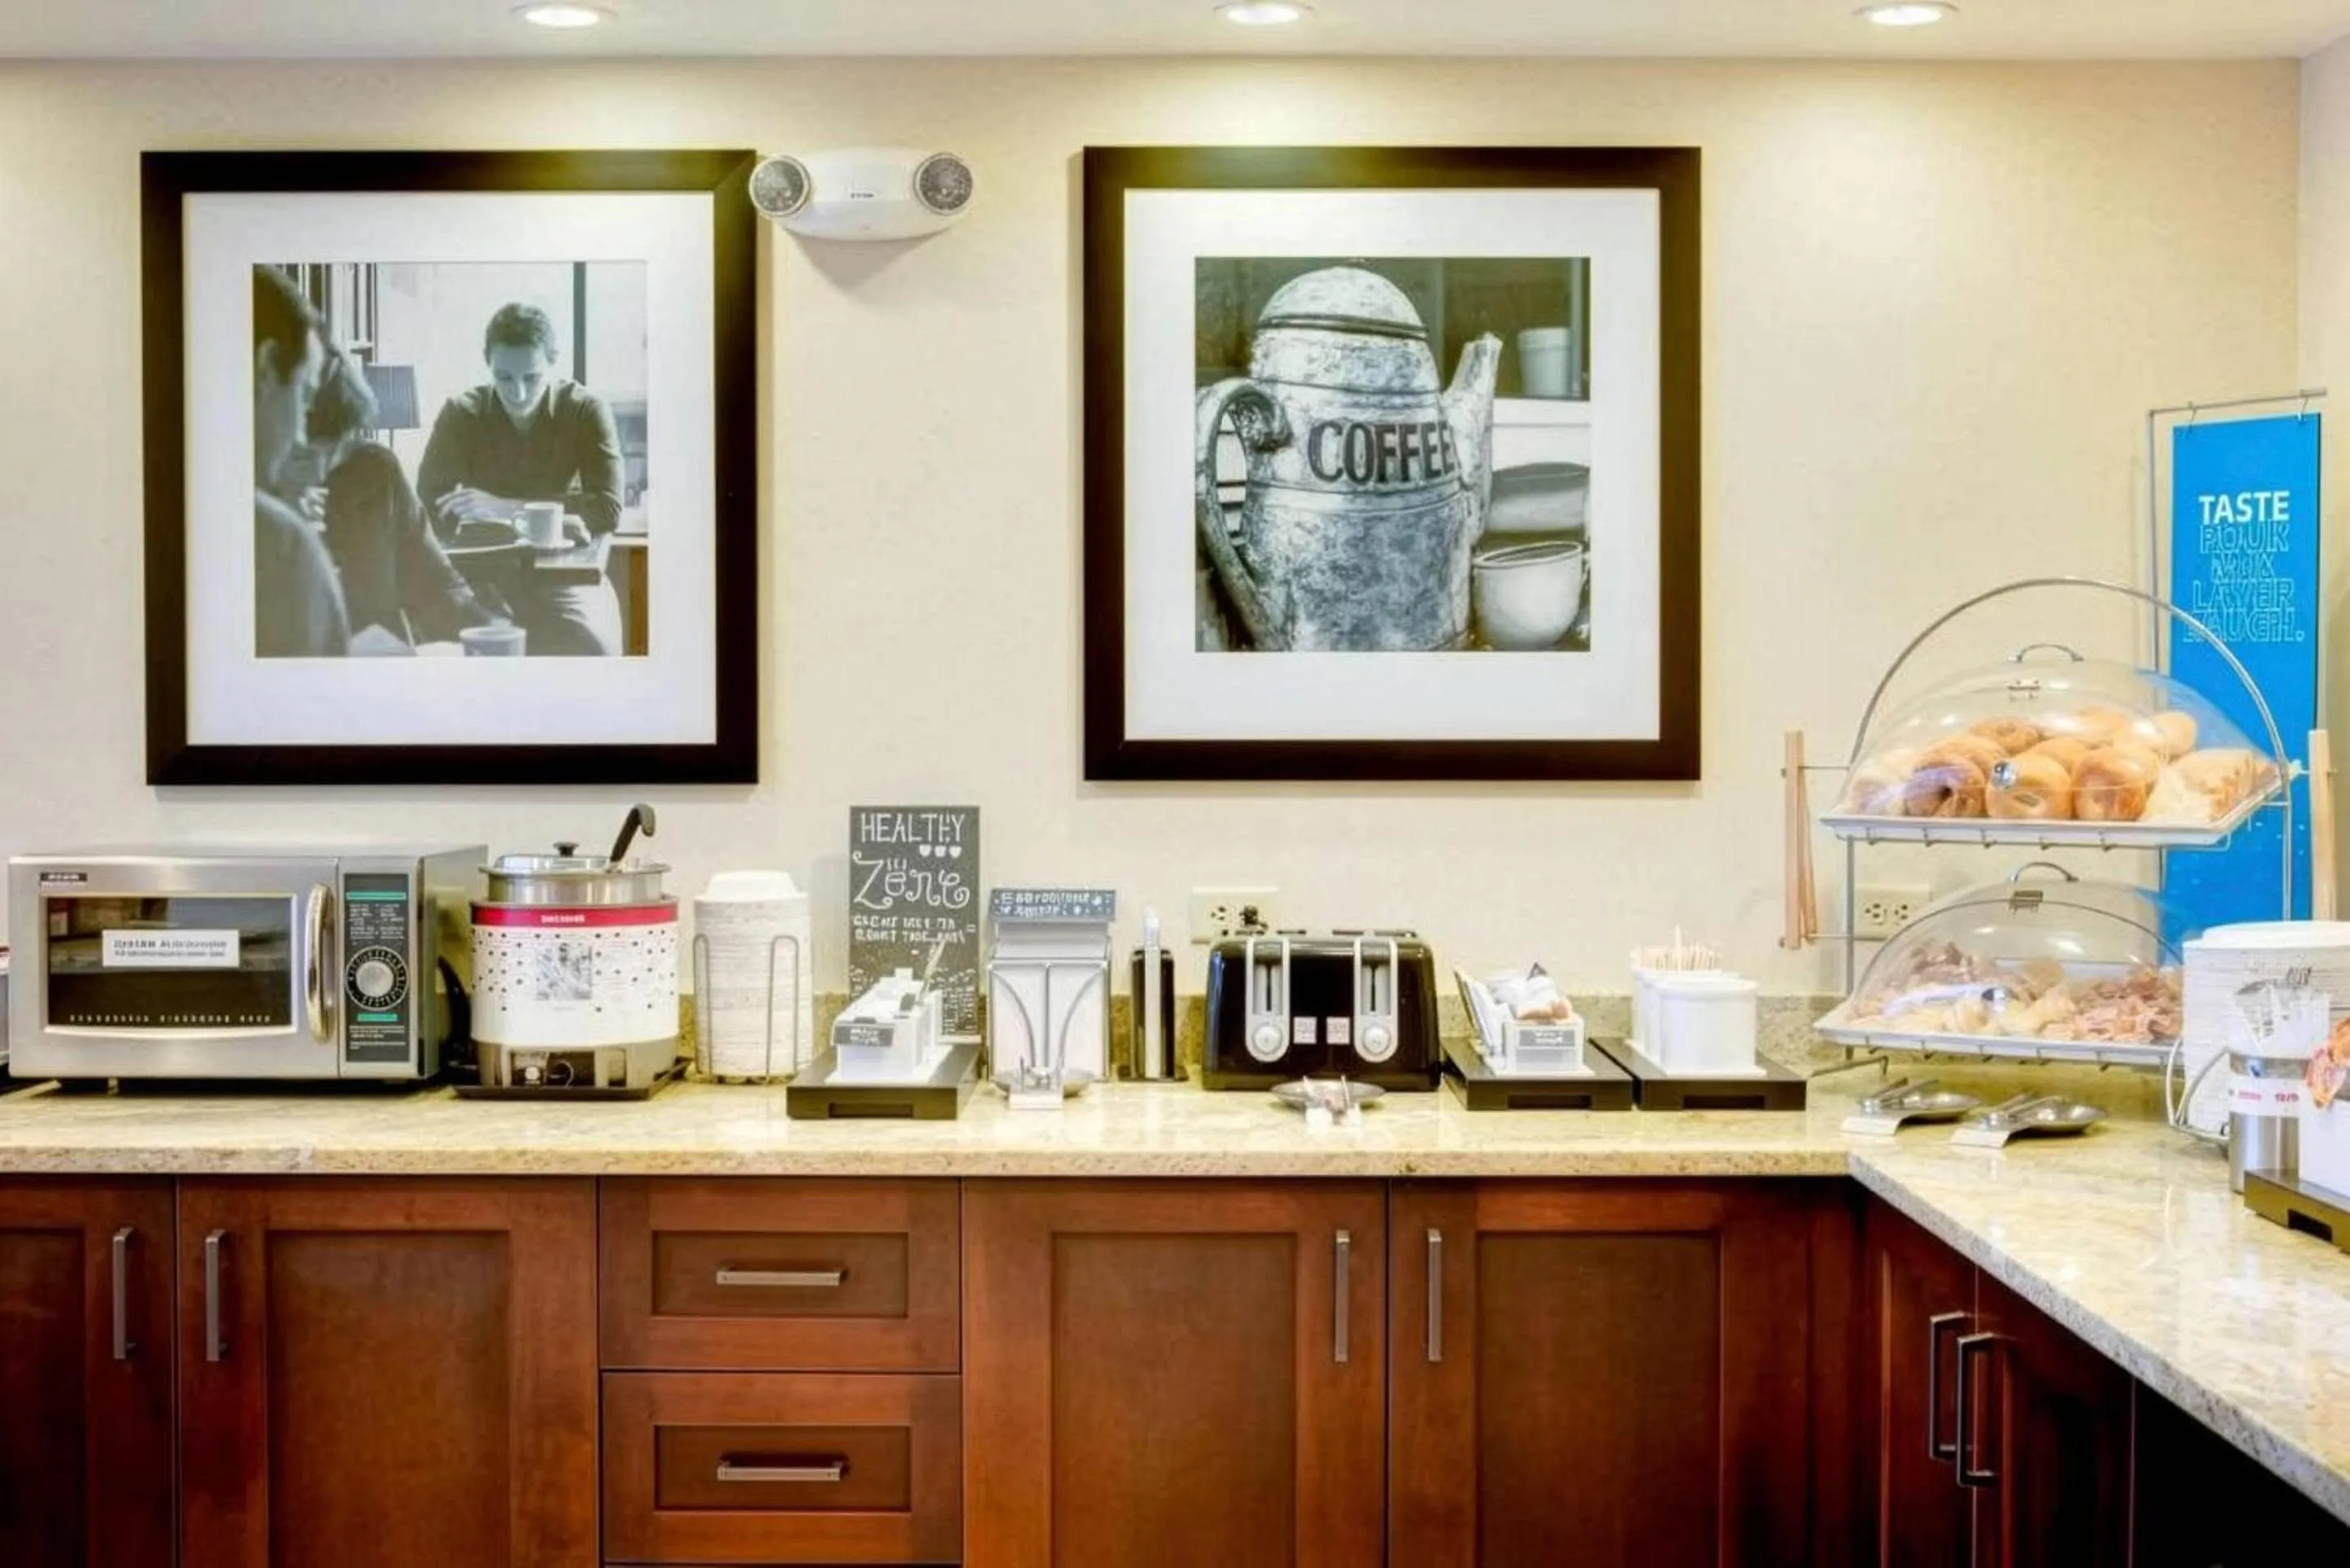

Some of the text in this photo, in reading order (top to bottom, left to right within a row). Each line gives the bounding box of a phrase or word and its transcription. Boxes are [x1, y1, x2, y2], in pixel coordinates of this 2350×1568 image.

[1308, 420, 1456, 485] COFFEE
[2198, 491, 2290, 526] TASTE
[2192, 578, 2295, 613] LAYER
[861, 811, 966, 842] HEALTHY
